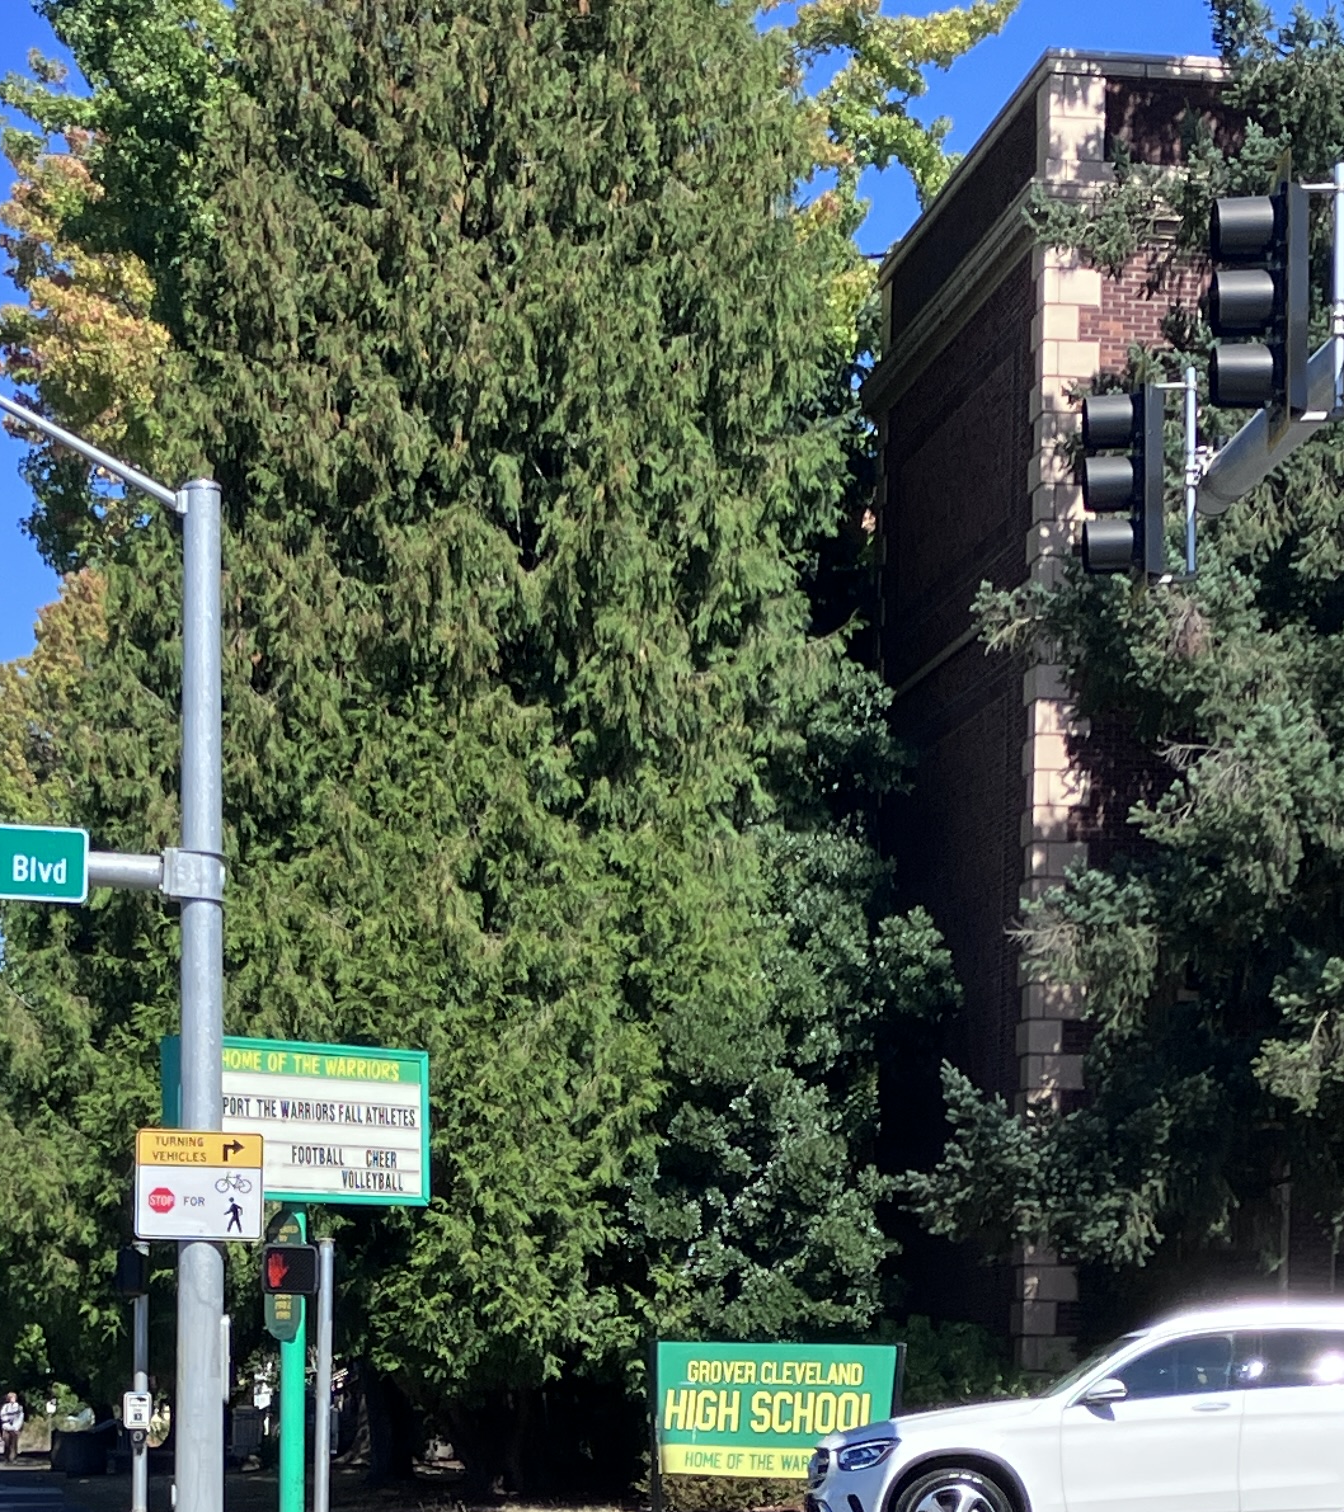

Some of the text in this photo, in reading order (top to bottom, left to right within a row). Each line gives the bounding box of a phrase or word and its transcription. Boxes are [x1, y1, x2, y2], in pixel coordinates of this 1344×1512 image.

[12, 853, 67, 885] Blvd
[223, 1048, 400, 1082] HOME OF THE WARRIORS
[223, 1096, 416, 1127] PORT THE WARRIORS FALL ATHLETES
[155, 1136, 204, 1147] TURNING
[152, 1151, 207, 1163] VEHICLES
[291, 1145, 398, 1169] FOOTBALL CHEER
[341, 1170, 404, 1192] VOLLEYBALL
[149, 1194, 205, 1207] STOP FOR
[687, 1360, 864, 1386] GROVER CLEVELAND
[664, 1389, 741, 1433] HIGH
[684, 1452, 721, 1470] HOME
[726, 1453, 744, 1470] OF
[750, 1453, 775, 1471] THE
